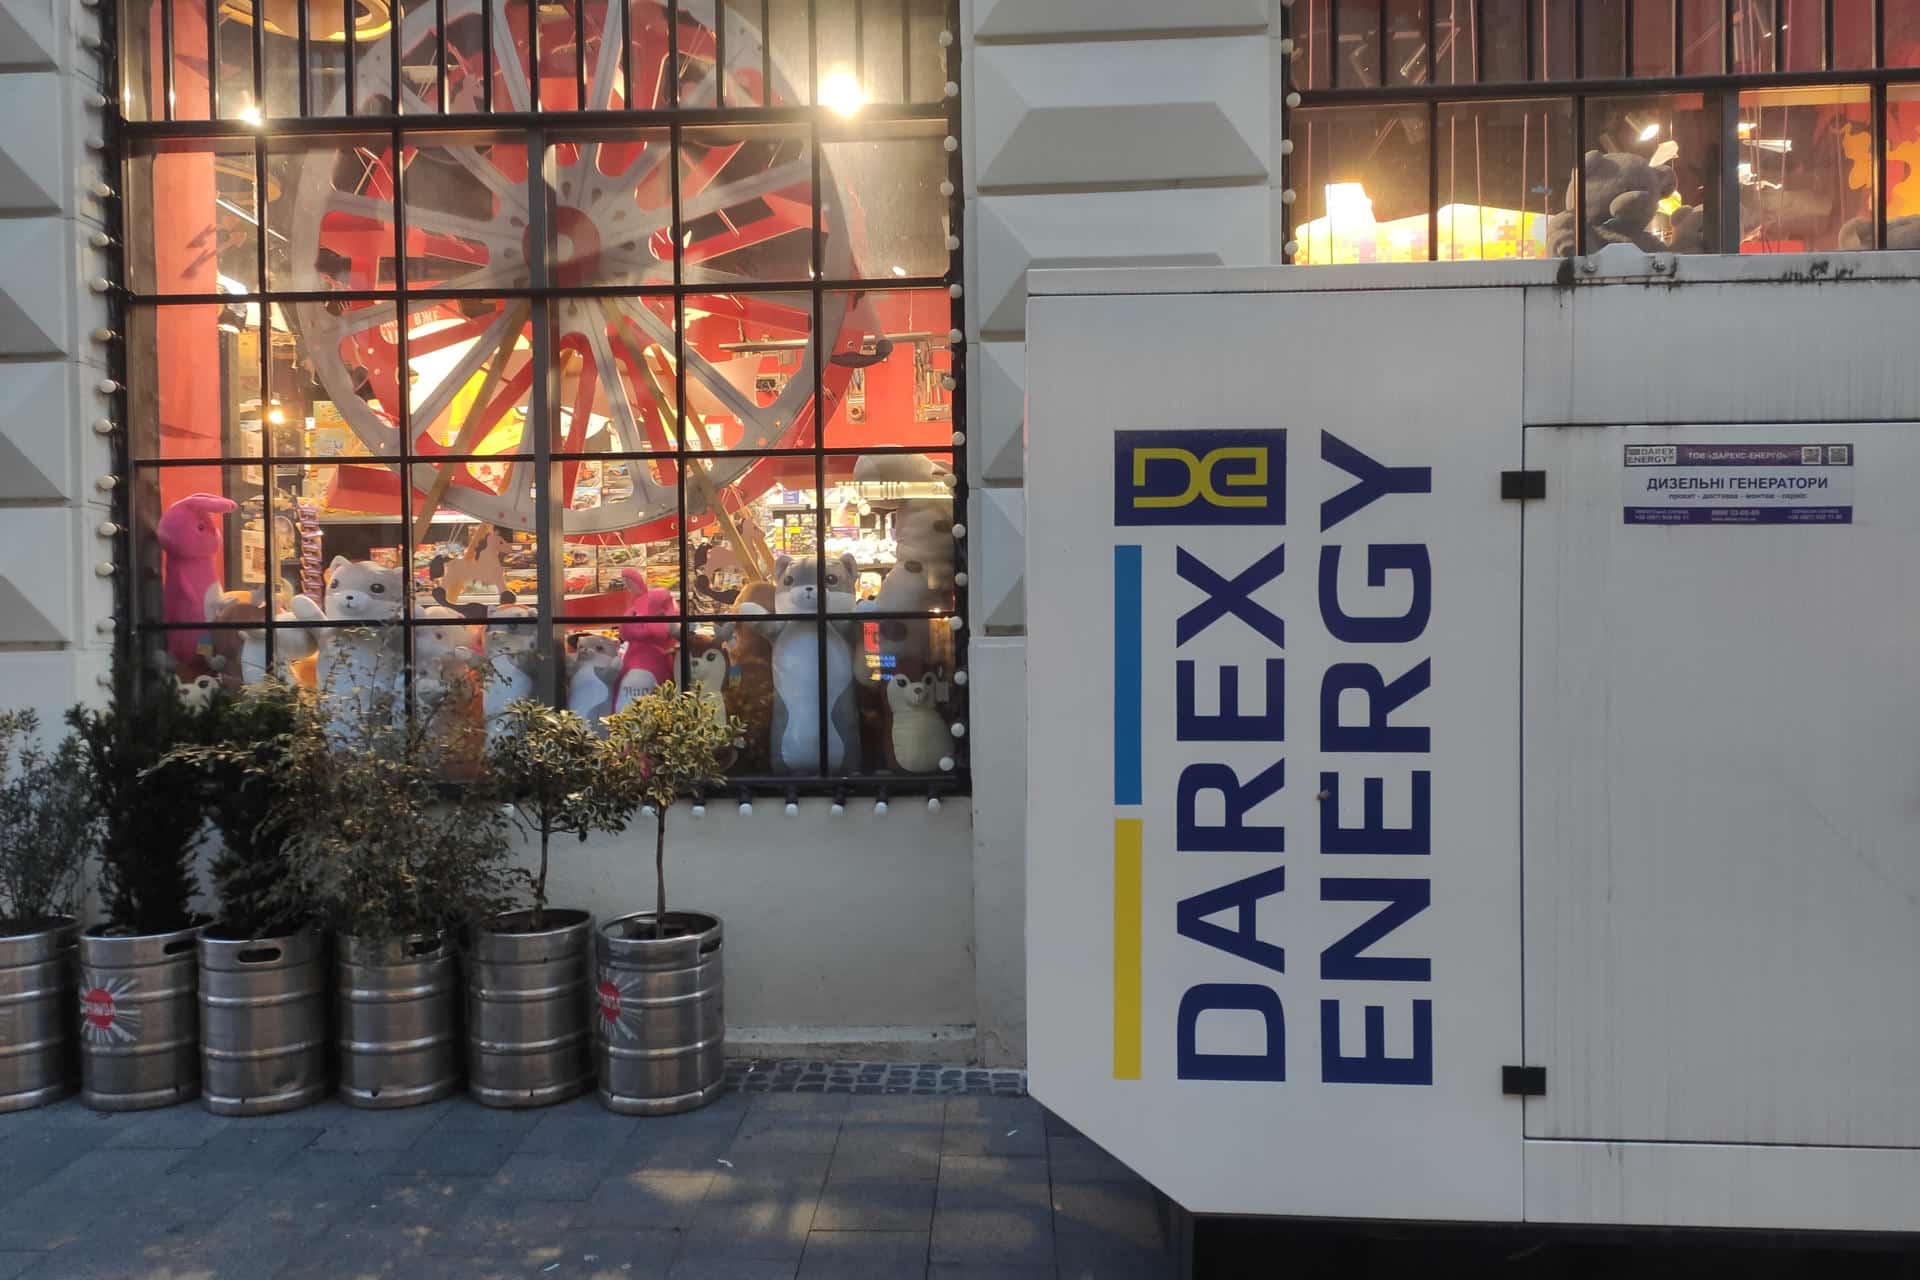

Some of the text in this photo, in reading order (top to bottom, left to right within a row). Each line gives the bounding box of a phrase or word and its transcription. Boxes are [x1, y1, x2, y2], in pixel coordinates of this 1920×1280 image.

[1646, 477, 1828, 492] ДИЗЕЛЬНІ ГЕНЕРАТОРИ
[1176, 542, 1286, 1082] DAREX
[1318, 428, 1433, 1086] ENERGY
